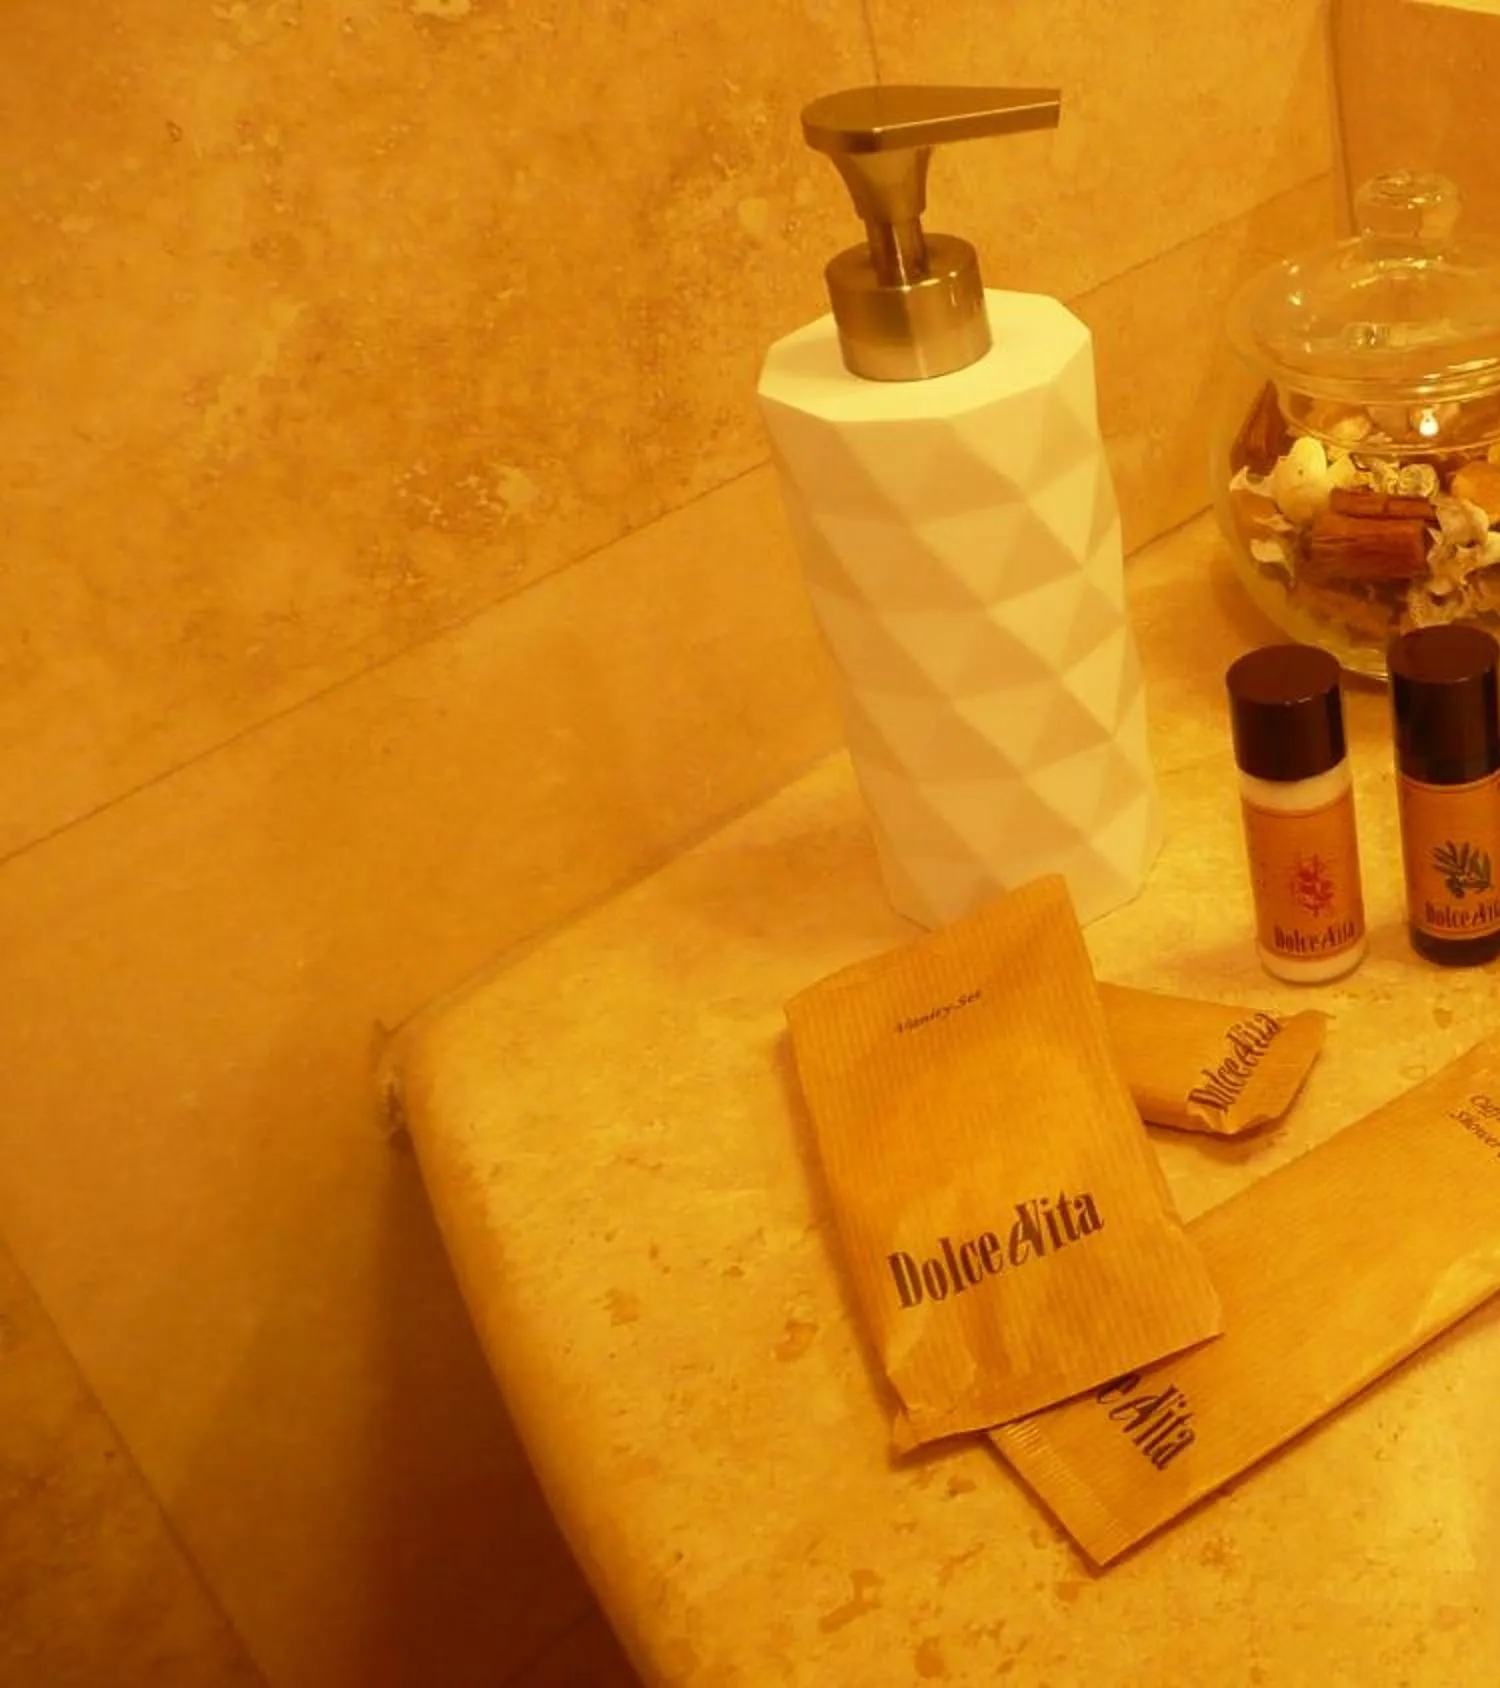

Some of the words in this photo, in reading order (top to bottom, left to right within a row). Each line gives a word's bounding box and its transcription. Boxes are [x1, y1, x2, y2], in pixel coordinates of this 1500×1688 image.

[1187, 1057, 1252, 1113] Dolce
[887, 1236, 1004, 1310] Dolce
[1007, 1189, 1106, 1268] Vita
